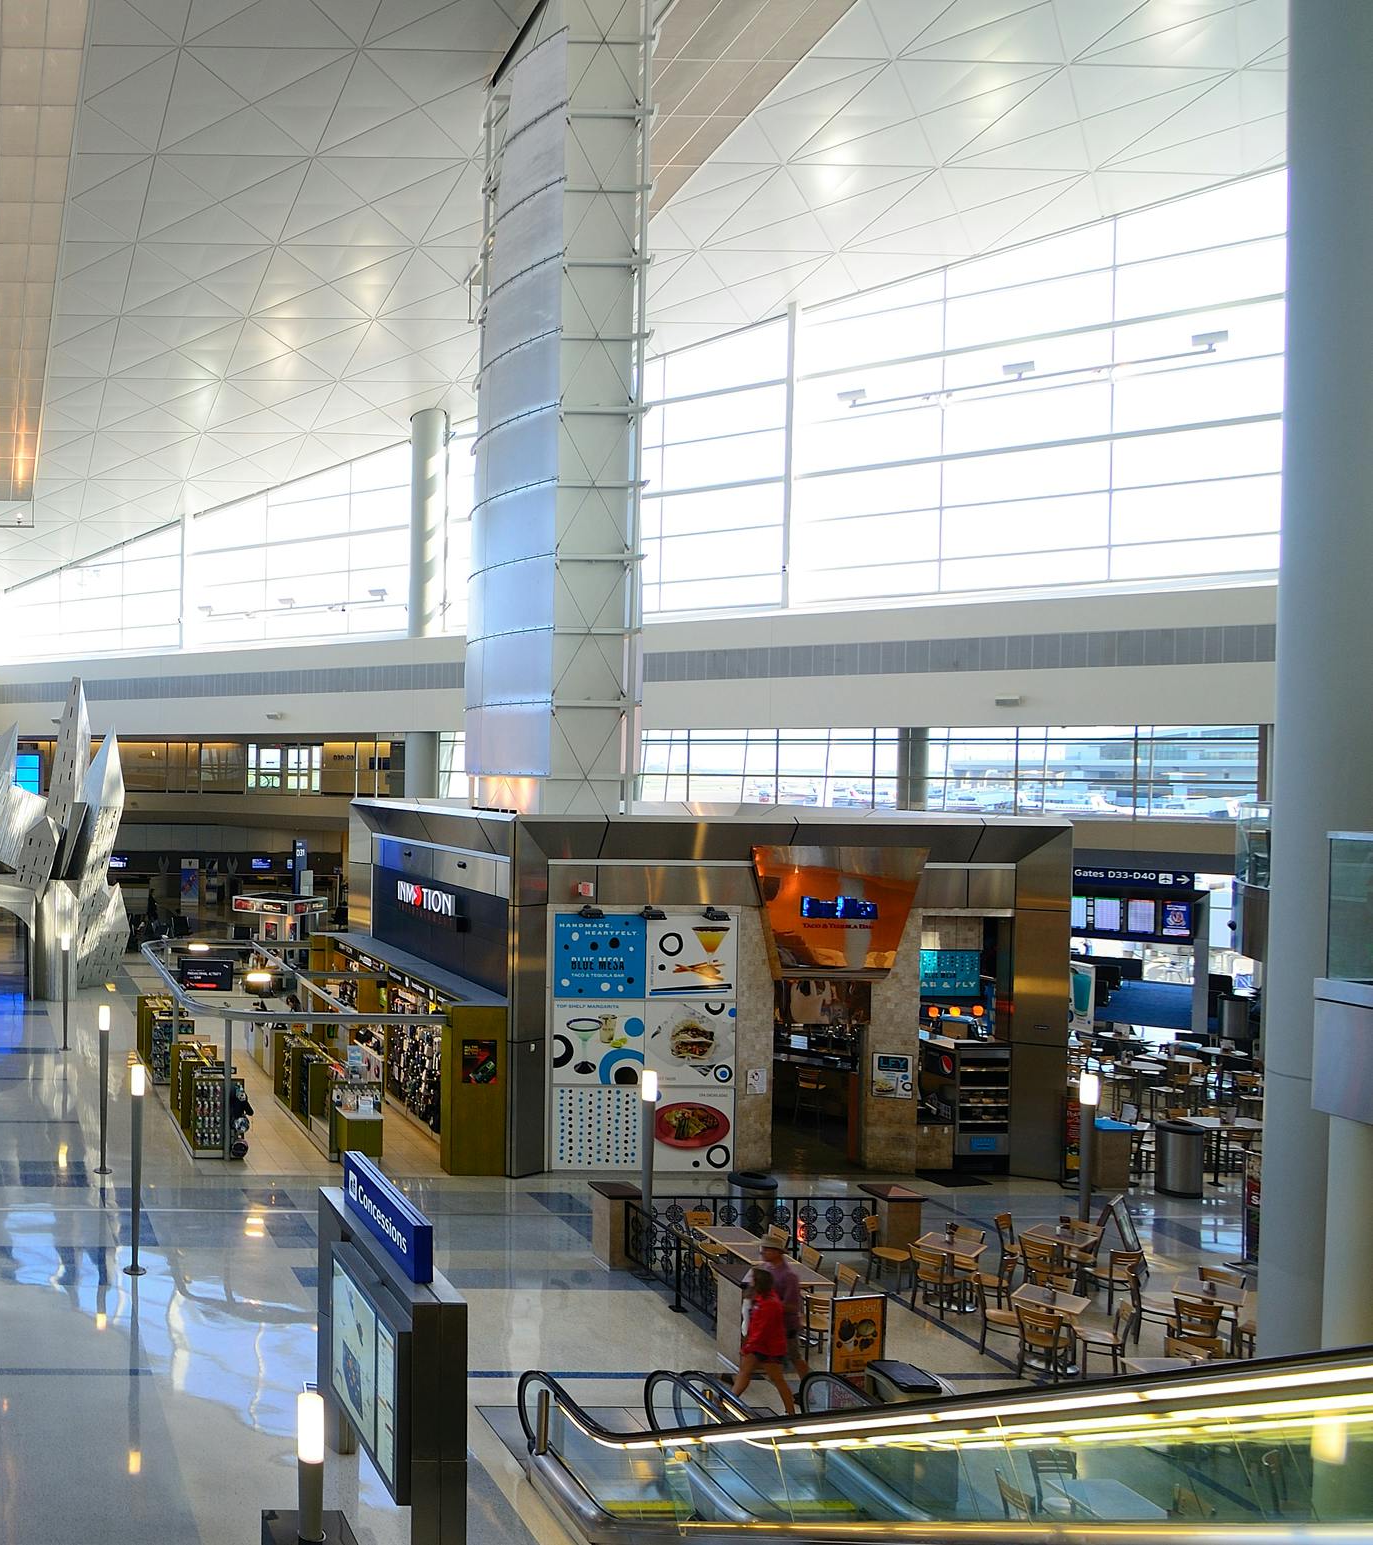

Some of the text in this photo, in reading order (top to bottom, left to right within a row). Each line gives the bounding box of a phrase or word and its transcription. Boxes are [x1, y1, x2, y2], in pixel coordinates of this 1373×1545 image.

[1074, 868, 1156, 881] Gates D33-D40
[571, 956, 625, 970] BLUE MESA
[358, 1185, 407, 1255] Concessions
